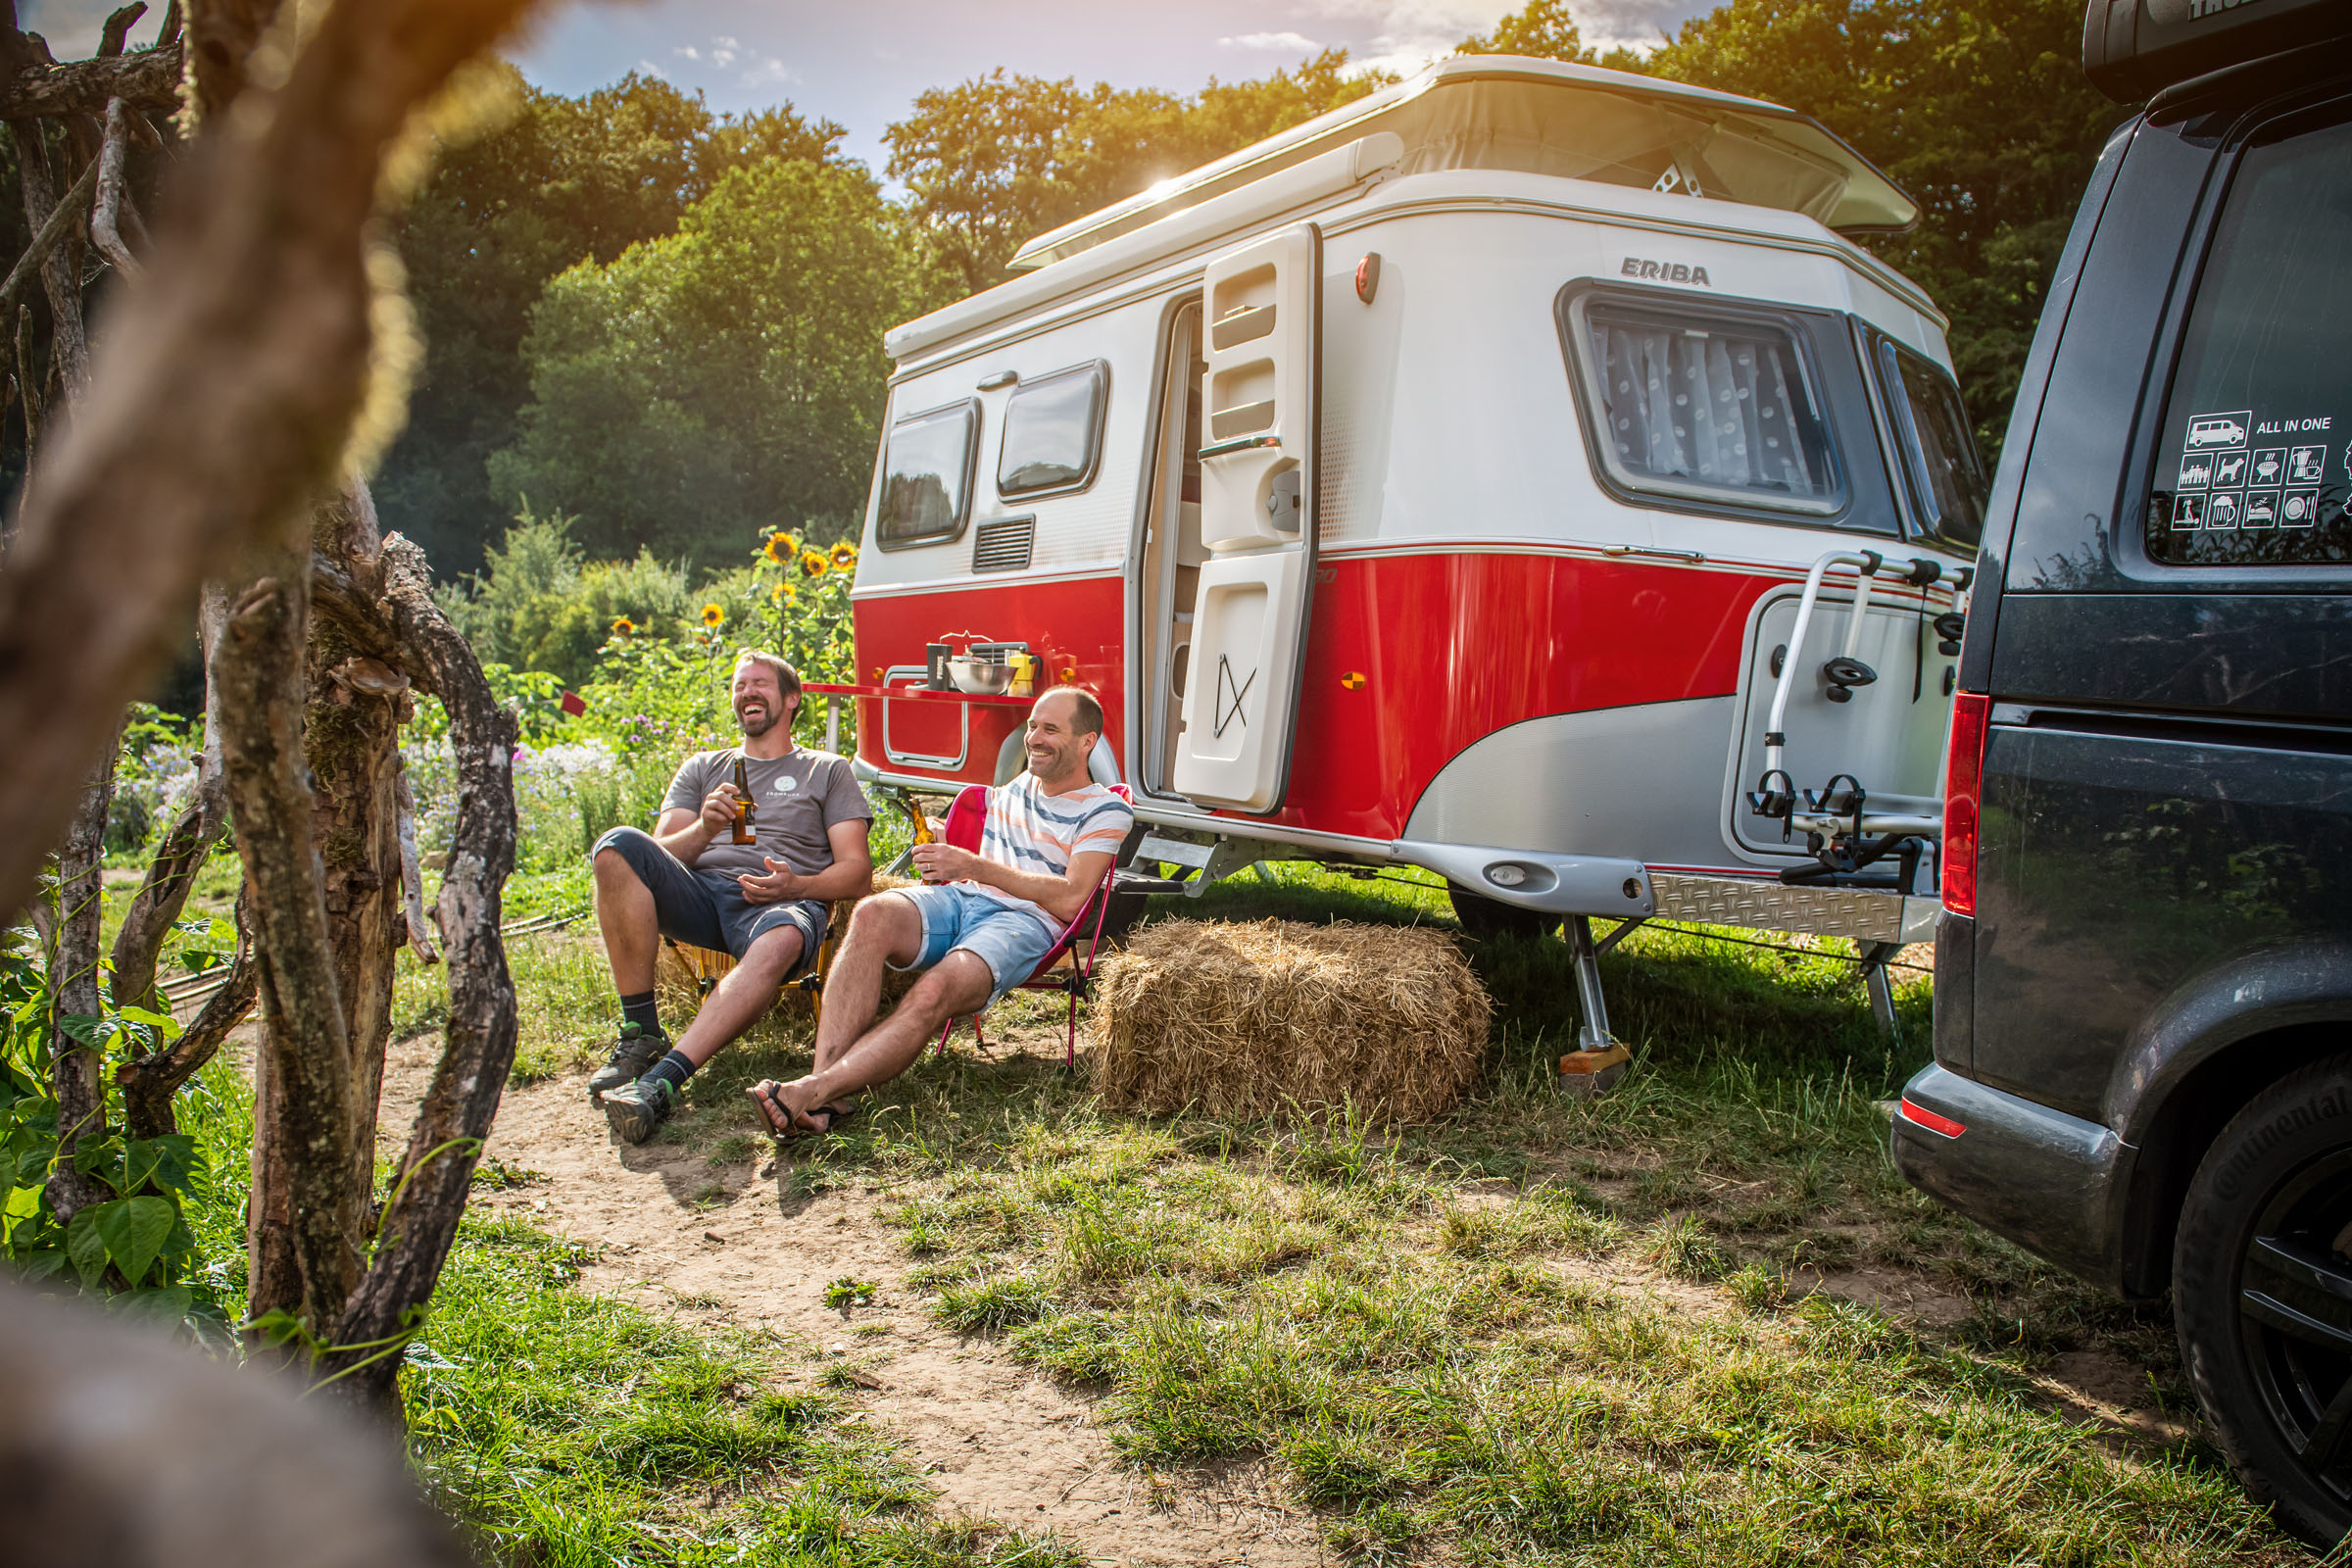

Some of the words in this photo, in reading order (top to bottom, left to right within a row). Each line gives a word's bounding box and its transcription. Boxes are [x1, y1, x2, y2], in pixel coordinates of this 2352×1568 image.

[1620, 257, 1711, 287] ERIBA
[2256, 420, 2281, 435] ALL
[2283, 418, 2299, 432] IN
[2300, 416, 2332, 431] ONE
[2212, 1085, 2352, 1201] Continental
